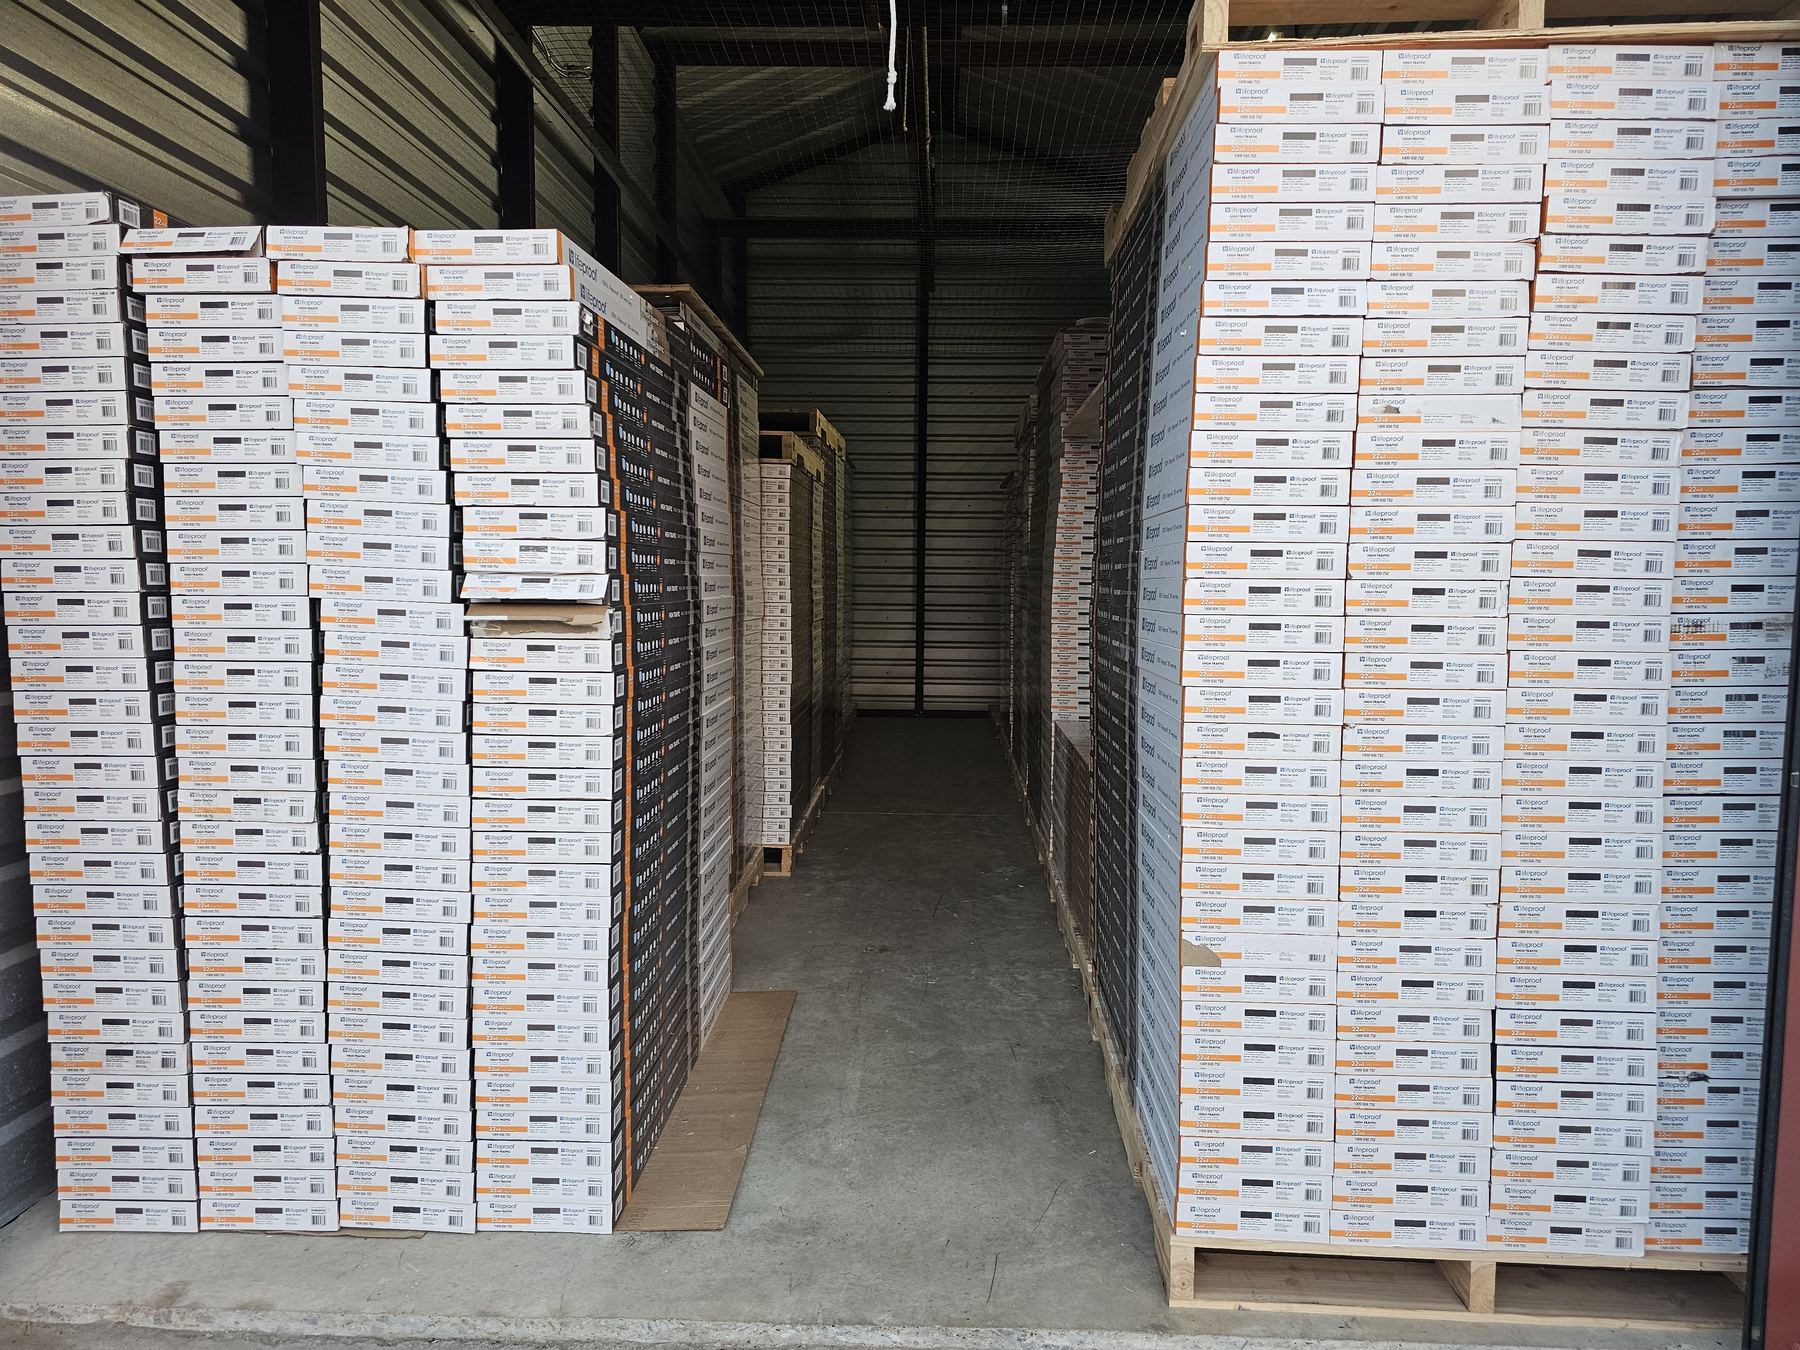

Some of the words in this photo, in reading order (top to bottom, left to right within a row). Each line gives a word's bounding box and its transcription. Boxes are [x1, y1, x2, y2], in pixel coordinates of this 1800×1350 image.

[1730, 122, 1761, 131] lifeproof
[1732, 160, 1762, 169] lifeproof
[1227, 245, 1256, 253] lifeproof
[1707, 316, 1736, 325] lifeproof
[1382, 321, 1412, 330] lifeproof
[1380, 360, 1409, 369] lifeproof
[1699, 392, 1729, 401] lifeproof
[1695, 431, 1724, 439] lifeproof
[1370, 509, 1399, 518] lifeproof
[1690, 505, 1719, 514] lifeproof
[1683, 652, 1712, 661] lifeproof
[1678, 726, 1706, 734] lifeproof
[1676, 761, 1704, 770] lifeproof
[1511, 1154, 1539, 1162] lifeproof
[1510, 1187, 1538, 1196] lifeproof
[1195, 1206, 1222, 1214] lifeproof
